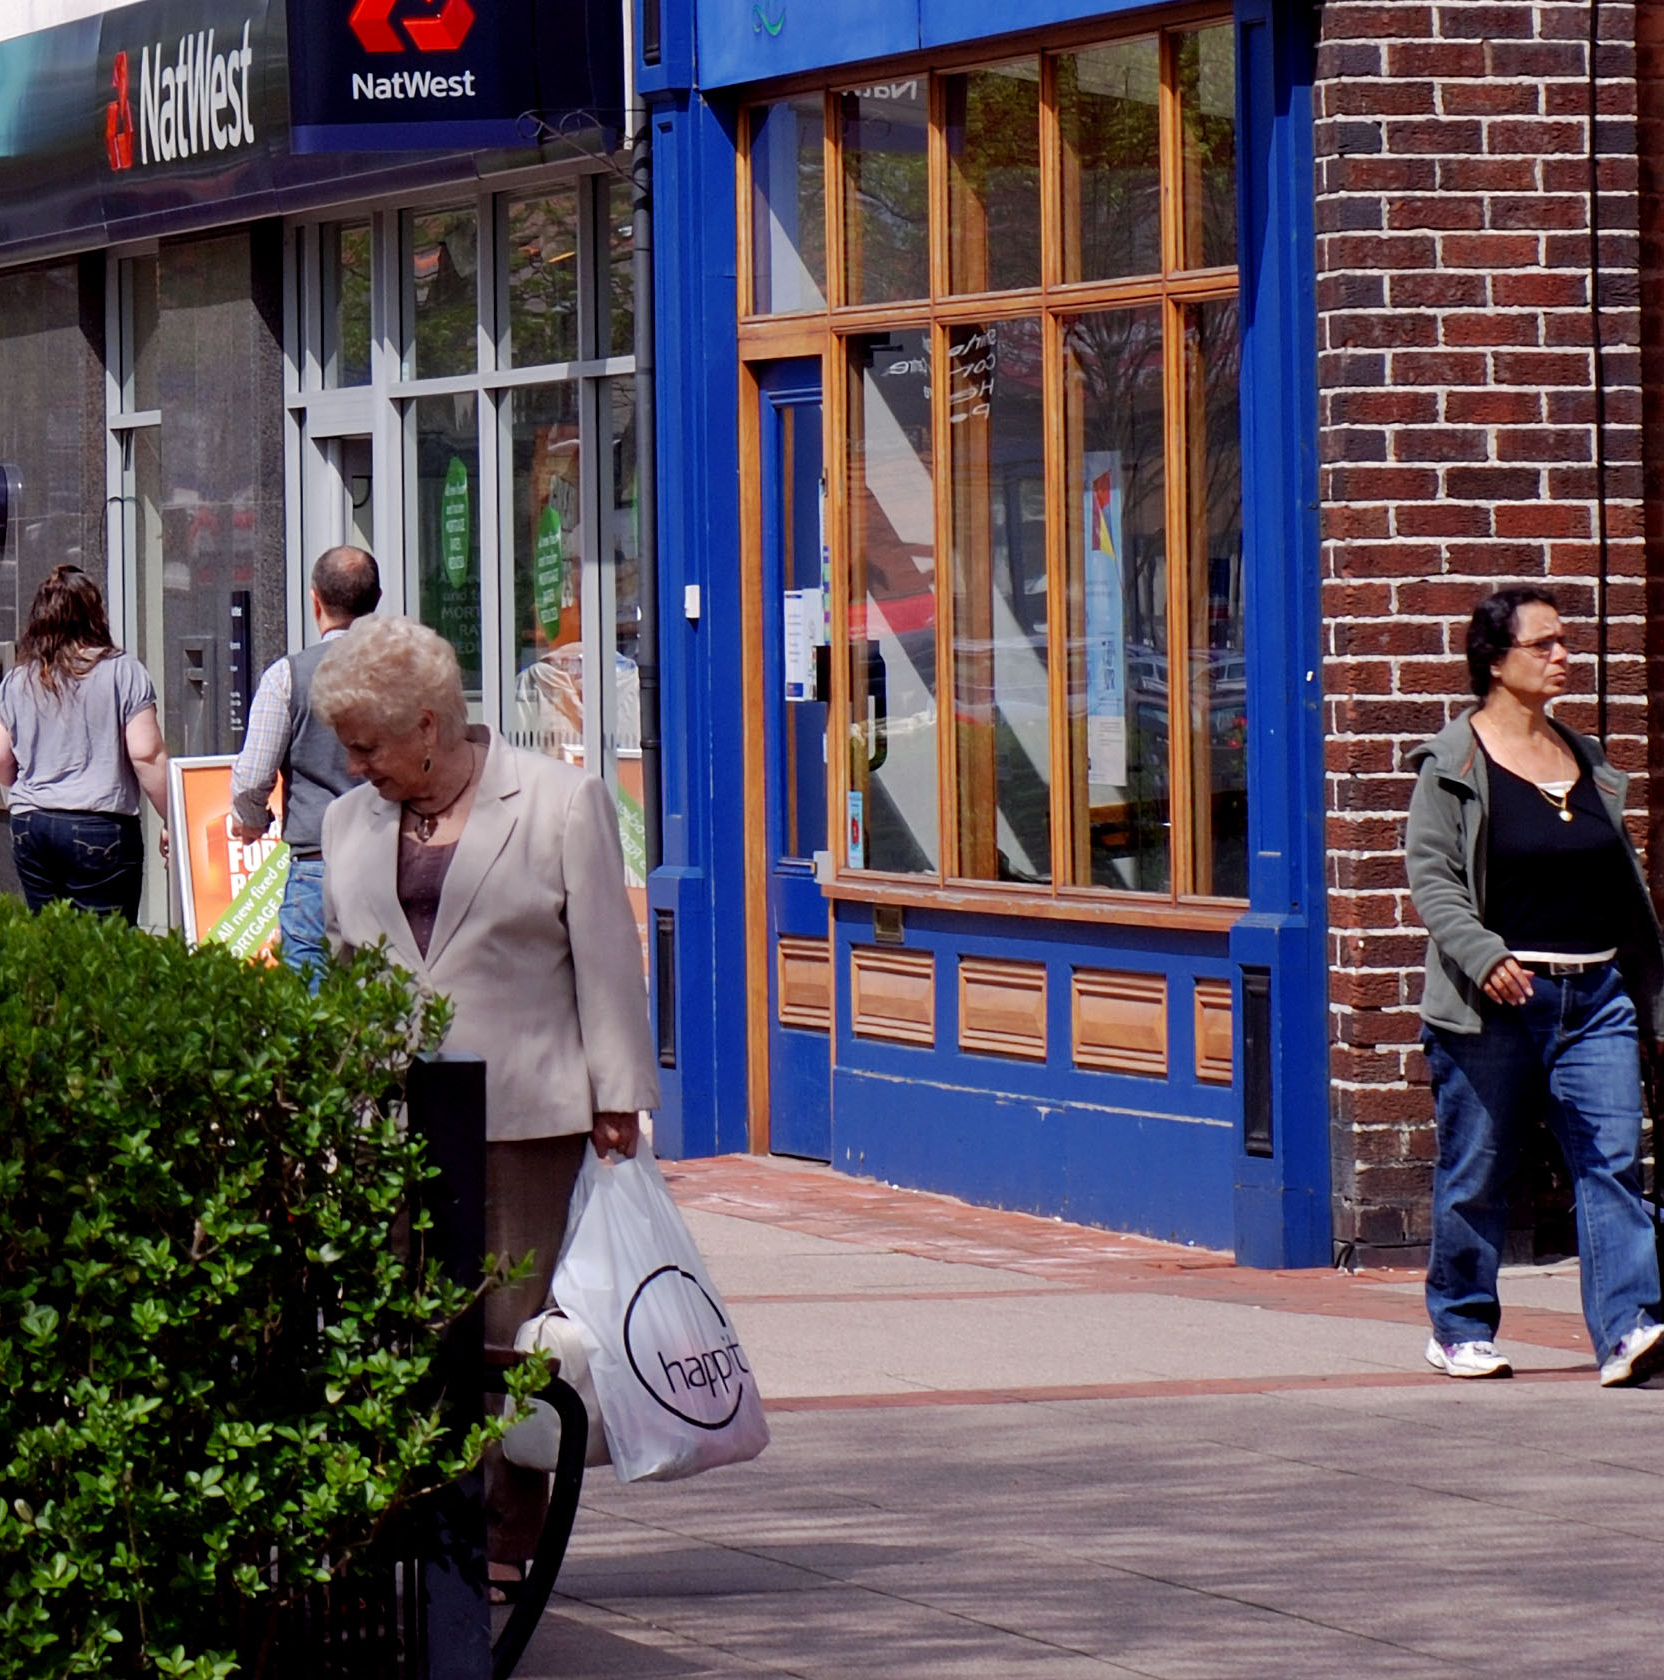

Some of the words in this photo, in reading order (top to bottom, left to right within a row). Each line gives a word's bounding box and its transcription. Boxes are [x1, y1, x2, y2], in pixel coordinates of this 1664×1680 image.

[140, 19, 254, 165] NatWest
[352, 70, 476, 100] NatWest
[217, 920, 236, 943] All
[231, 898, 256, 928] new
[249, 865, 279, 899] fixed
[229, 896, 283, 960] ORTGAGE
[657, 1334, 750, 1398] happit
